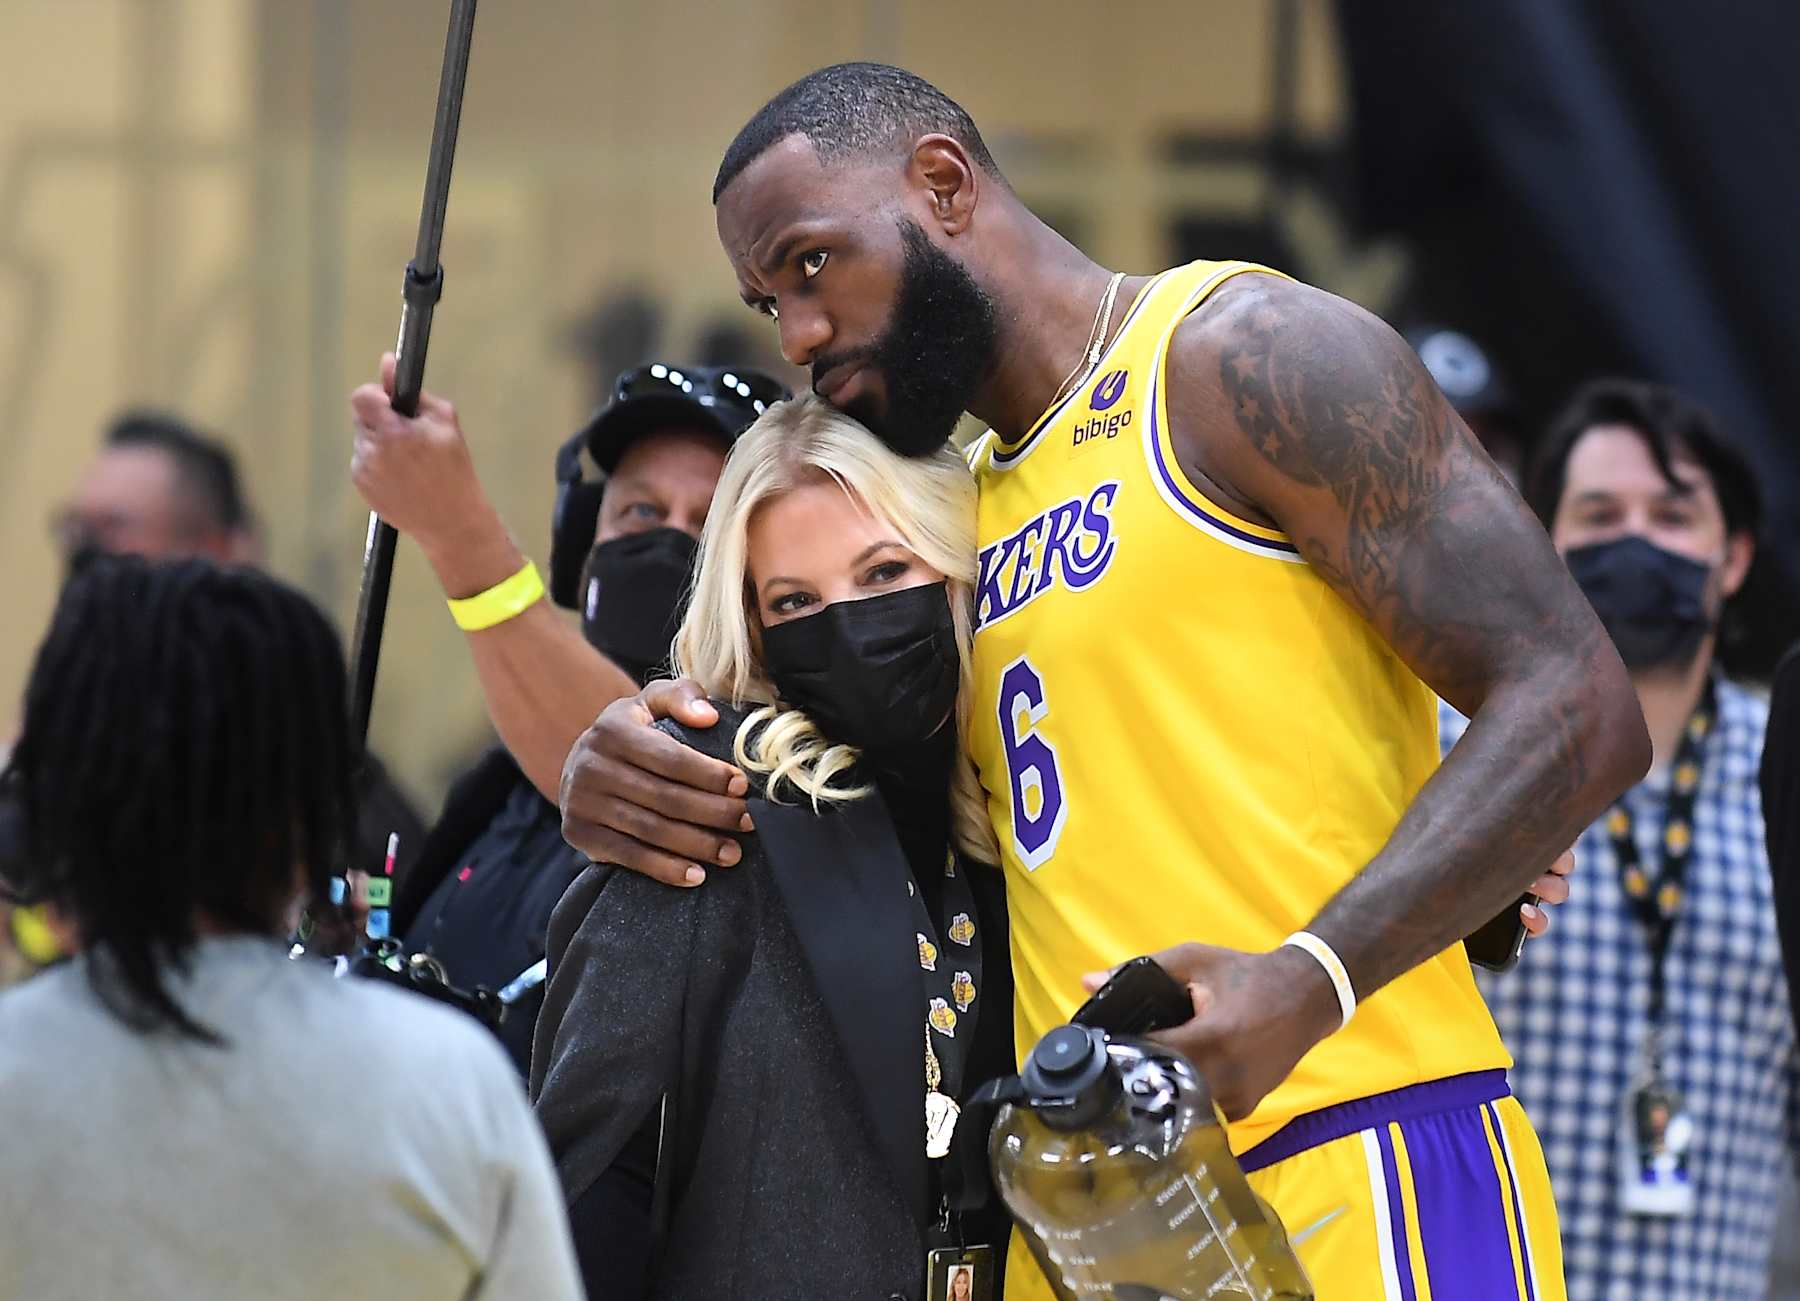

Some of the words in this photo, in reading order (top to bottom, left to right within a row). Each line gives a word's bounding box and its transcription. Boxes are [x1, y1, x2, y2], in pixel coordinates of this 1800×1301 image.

[1072, 409, 1132, 447] bibigo
[974, 479, 1121, 634] KERS
[996, 654, 1068, 872] 6
